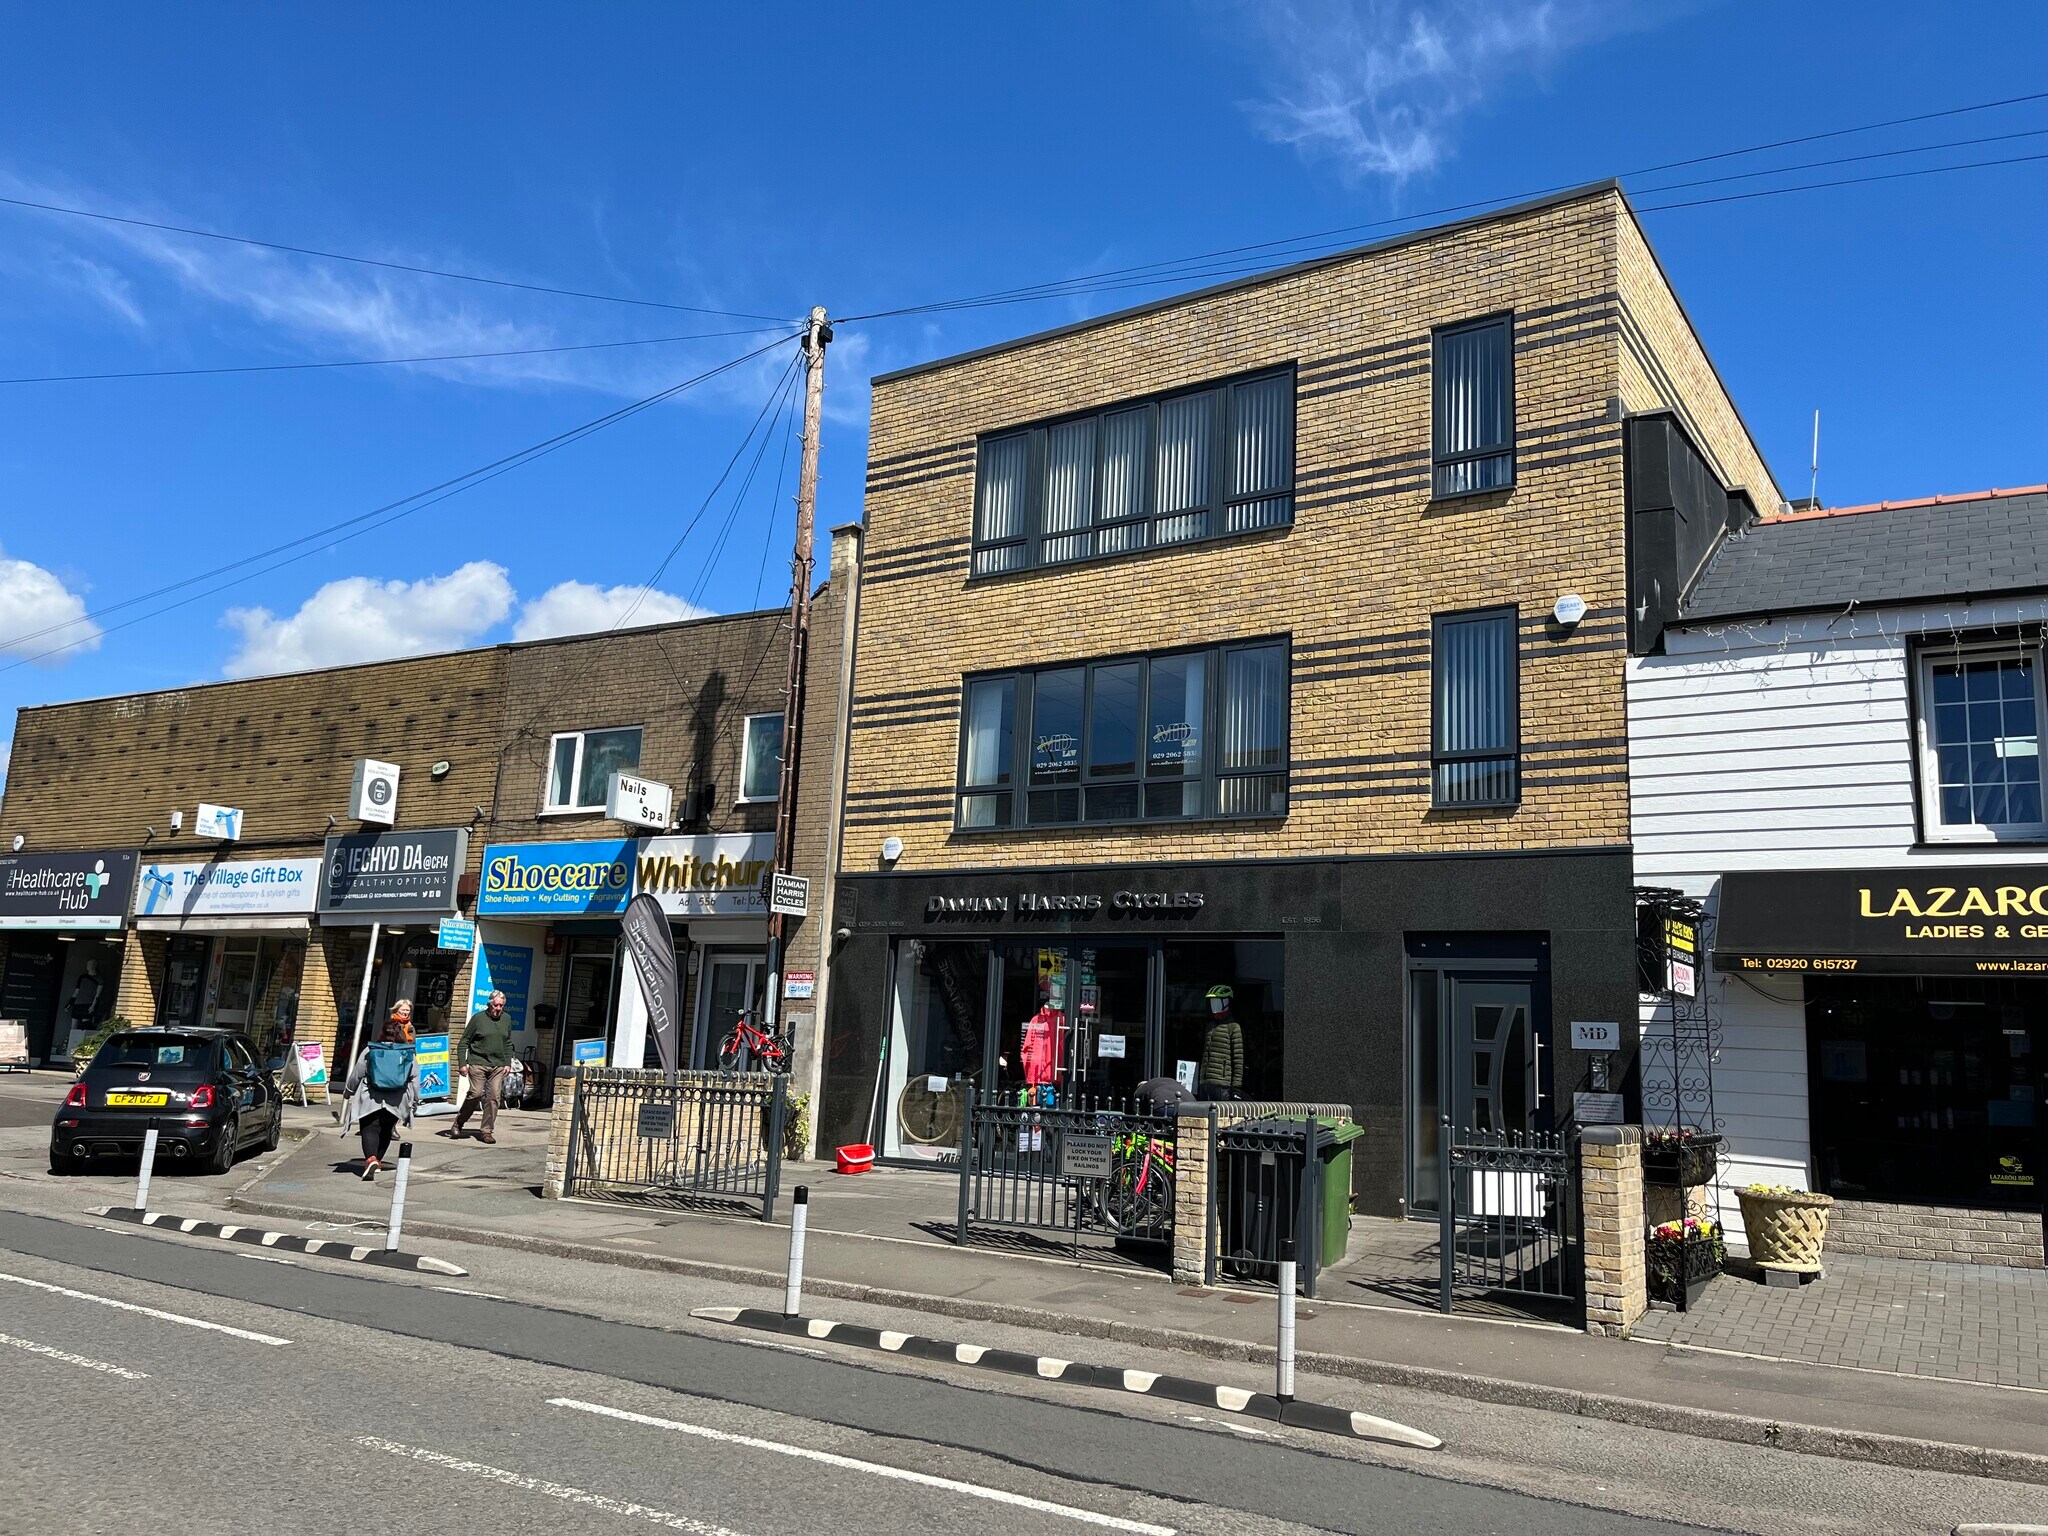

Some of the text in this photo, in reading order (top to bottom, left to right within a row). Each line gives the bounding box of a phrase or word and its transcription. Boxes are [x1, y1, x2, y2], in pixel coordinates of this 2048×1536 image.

[1182, 738, 1197, 748] LAW
[1062, 750, 1076, 758] LAW
[1048, 760, 1062, 768] 2062
[620, 778, 647, 796] Nails
[642, 806, 662, 822] Spa
[348, 844, 448, 872] IECHYD DA @CF14
[12, 868, 84, 888] Healthcare
[184, 867, 303, 888] The Village Gift Box
[486, 855, 628, 892] Shoecare
[346, 876, 447, 888] HEALTHY OPTIONS
[777, 878, 806, 889] DAMIAN
[220, 890, 258, 900] contemporary
[266, 888, 286, 898] stylish
[286, 888, 300, 898] gifts
[778, 887, 804, 898] HARRIS
[59, 889, 88, 910] Hub
[485, 893, 626, 904] Shoe Repairs Key Cutting Engraving
[679, 896, 764, 906] Ad: 55b Tel: 02
[776, 896, 804, 906] CYCLES
[928, 890, 1205, 912] DAMIAN HARRIS CYCLES
[1906, 925, 1984, 938] LADIES
[1994, 925, 2010, 938] &
[408, 946, 420, 956] Siop
[420, 946, 435, 956] Bwyd
[486, 948, 526, 959] Shoe Repairs
[486, 962, 522, 973] Key Cutting
[1742, 958, 2048, 970] Tel: 02920 615737 www.lazar
[488, 977, 518, 986] Engraving
[1579, 1026, 1608, 1040] MD
[114, 1095, 138, 1104] CF21
